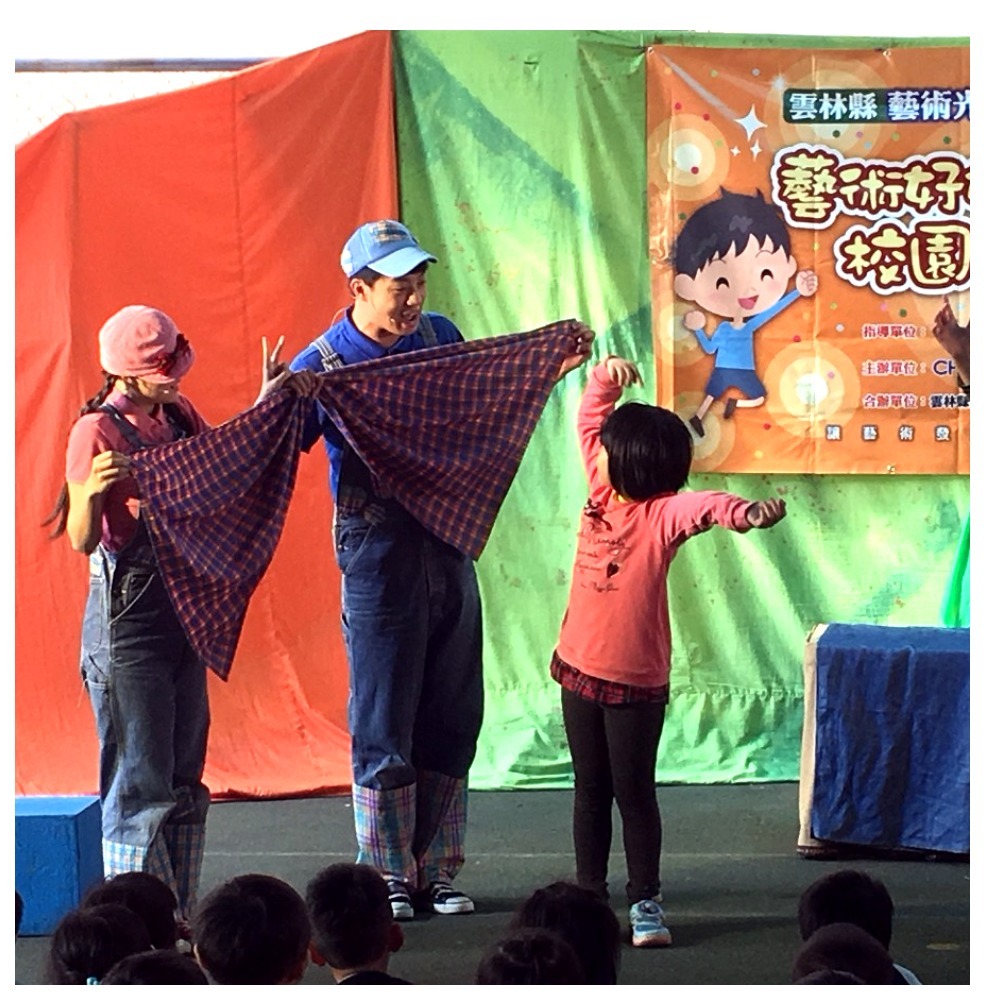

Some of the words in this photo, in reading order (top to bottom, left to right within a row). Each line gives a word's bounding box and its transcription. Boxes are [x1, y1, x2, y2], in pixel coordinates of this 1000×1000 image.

[789, 91, 878, 120] 雲林縣
[777, 149, 970, 222] 藝術好
[841, 223, 970, 289] 校園
